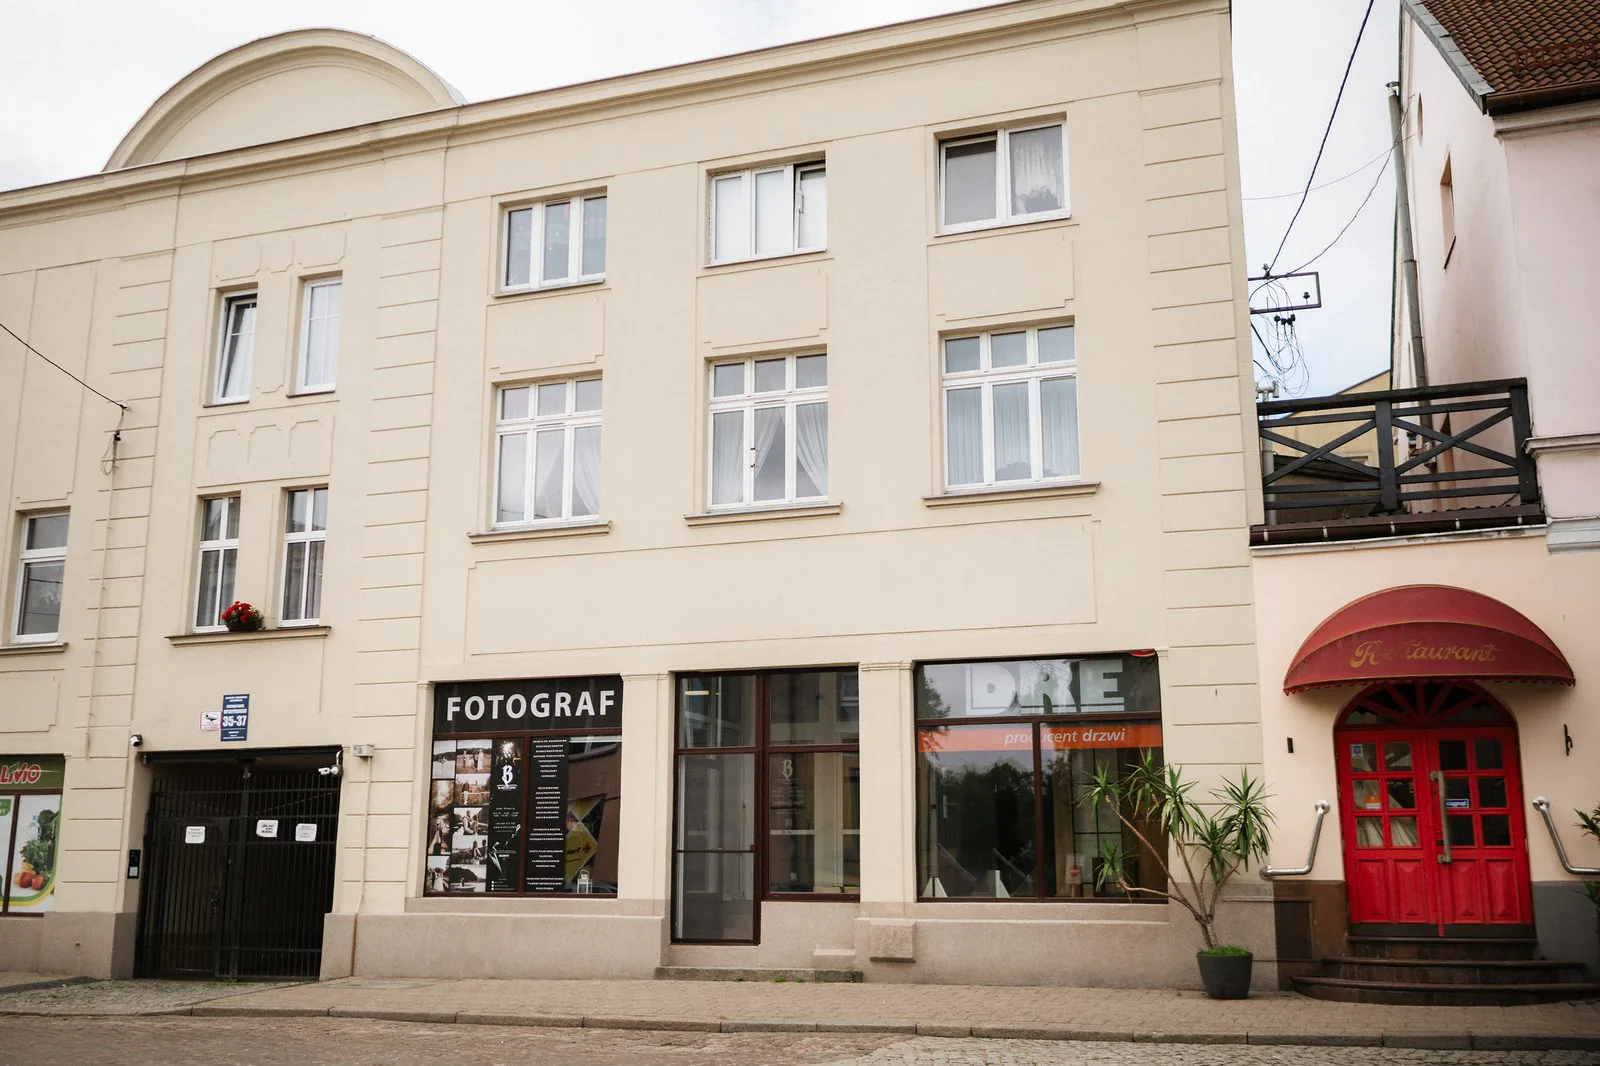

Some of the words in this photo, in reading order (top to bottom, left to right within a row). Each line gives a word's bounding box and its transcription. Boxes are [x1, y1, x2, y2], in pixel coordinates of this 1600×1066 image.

[965, 659, 1125, 716] DRE
[446, 690, 615, 721] FOTOGRAF
[222, 715, 247, 727] 35-37
[1082, 728, 1126, 742] drzwi
